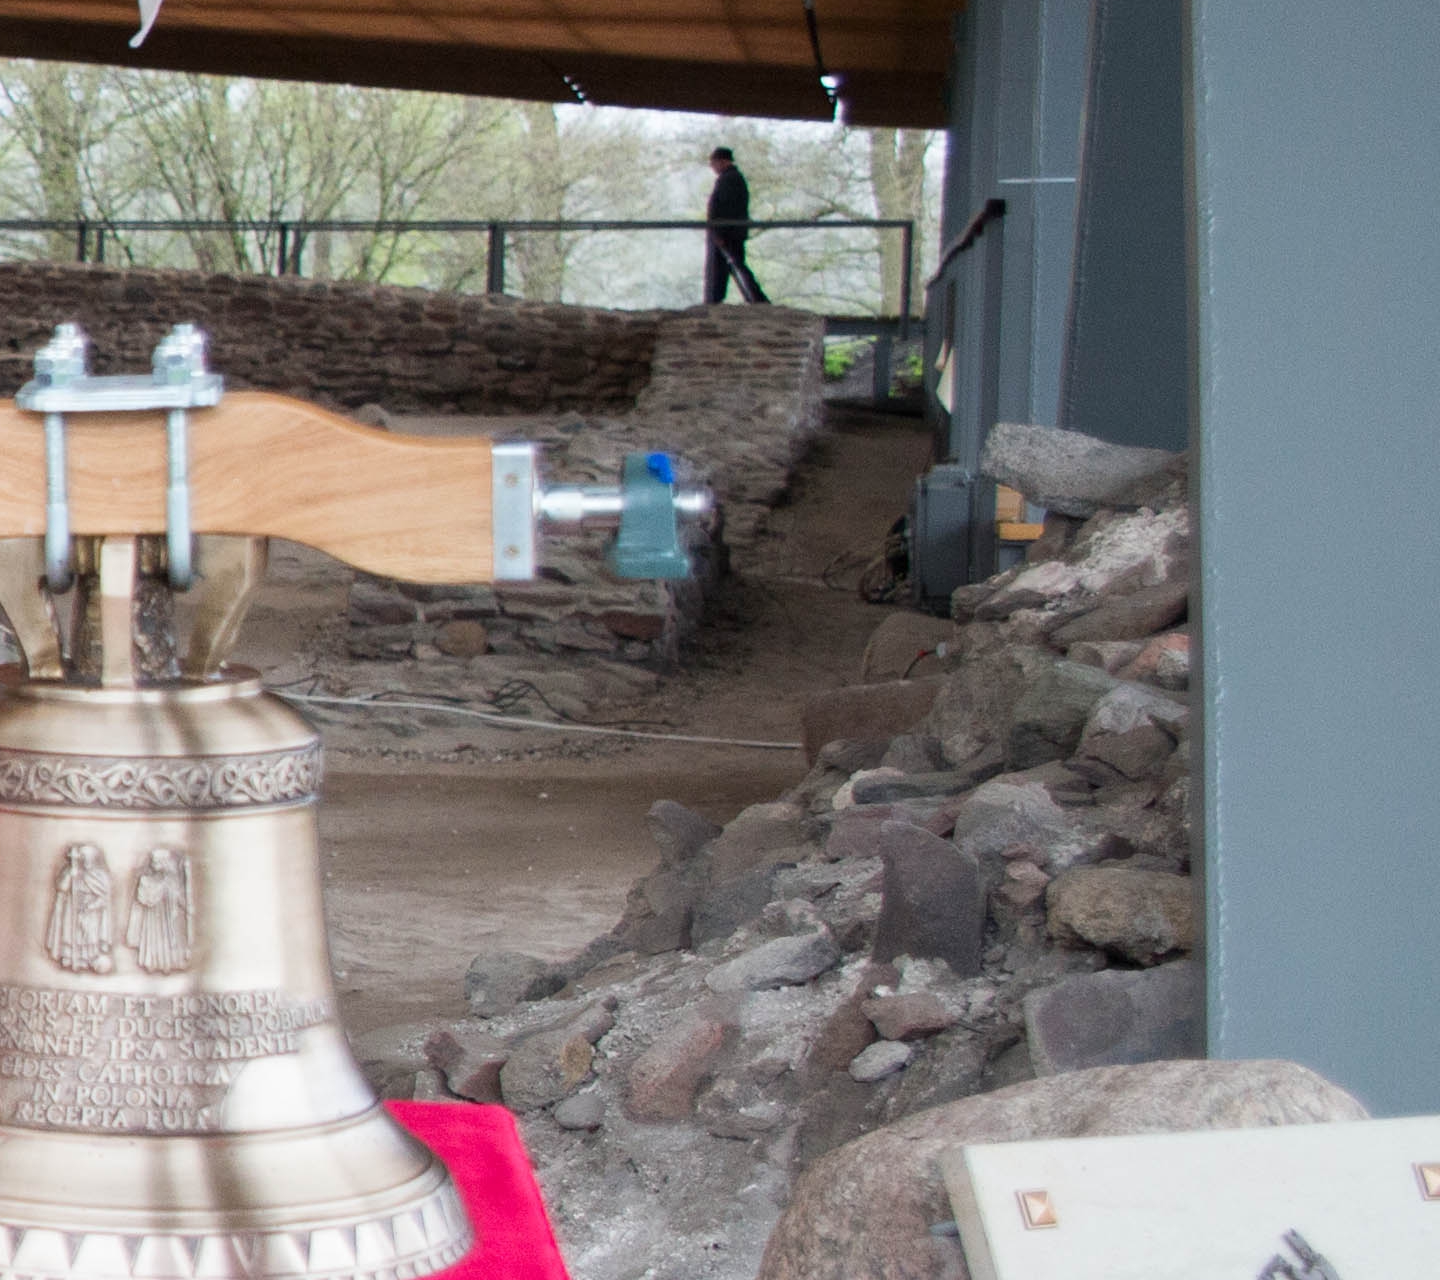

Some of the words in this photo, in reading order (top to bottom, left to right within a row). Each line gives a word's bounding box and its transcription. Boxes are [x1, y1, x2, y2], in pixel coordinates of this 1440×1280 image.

[123, 996, 156, 1018] ET
[171, 990, 281, 1017] HONOREM
[71, 1013, 101, 1038] ET
[118, 1016, 249, 1040] DUCISSAE
[108, 1038, 168, 1061] IPSA
[179, 1031, 299, 1060] SUADENTE
[78, 1062, 230, 1085] CATHOLICA
[32, 1081, 61, 1104] IN
[76, 1086, 194, 1108] POLONIA
[15, 1101, 130, 1129] RECEPTA
